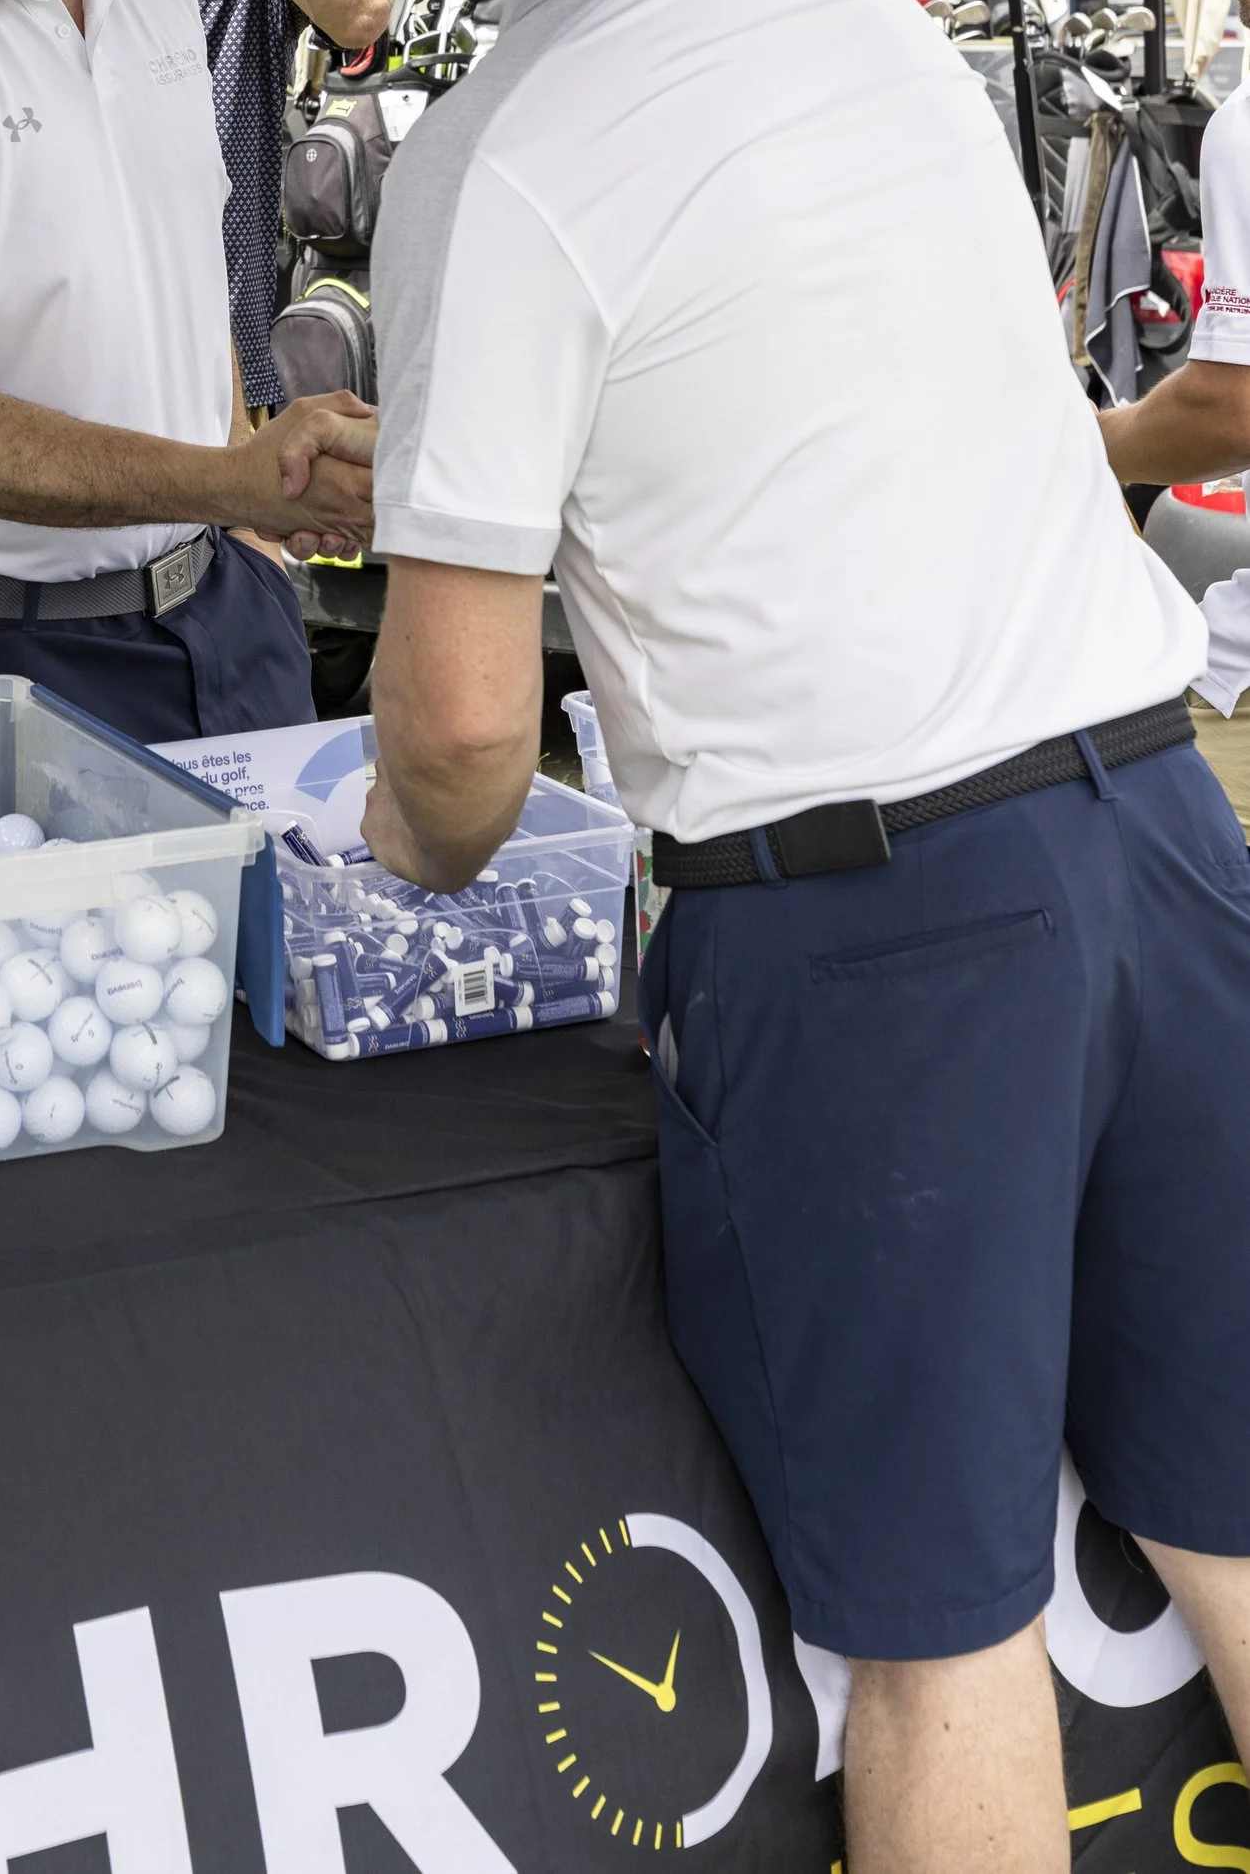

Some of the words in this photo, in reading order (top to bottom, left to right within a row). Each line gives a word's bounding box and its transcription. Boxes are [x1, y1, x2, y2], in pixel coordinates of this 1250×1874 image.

[201, 755, 230, 769] êtes
[233, 751, 252, 764] les
[221, 767, 250, 786] golf,
[235, 784, 265, 800] pros
[106, 978, 143, 997] beneva
[393, 972, 418, 996] beneva
